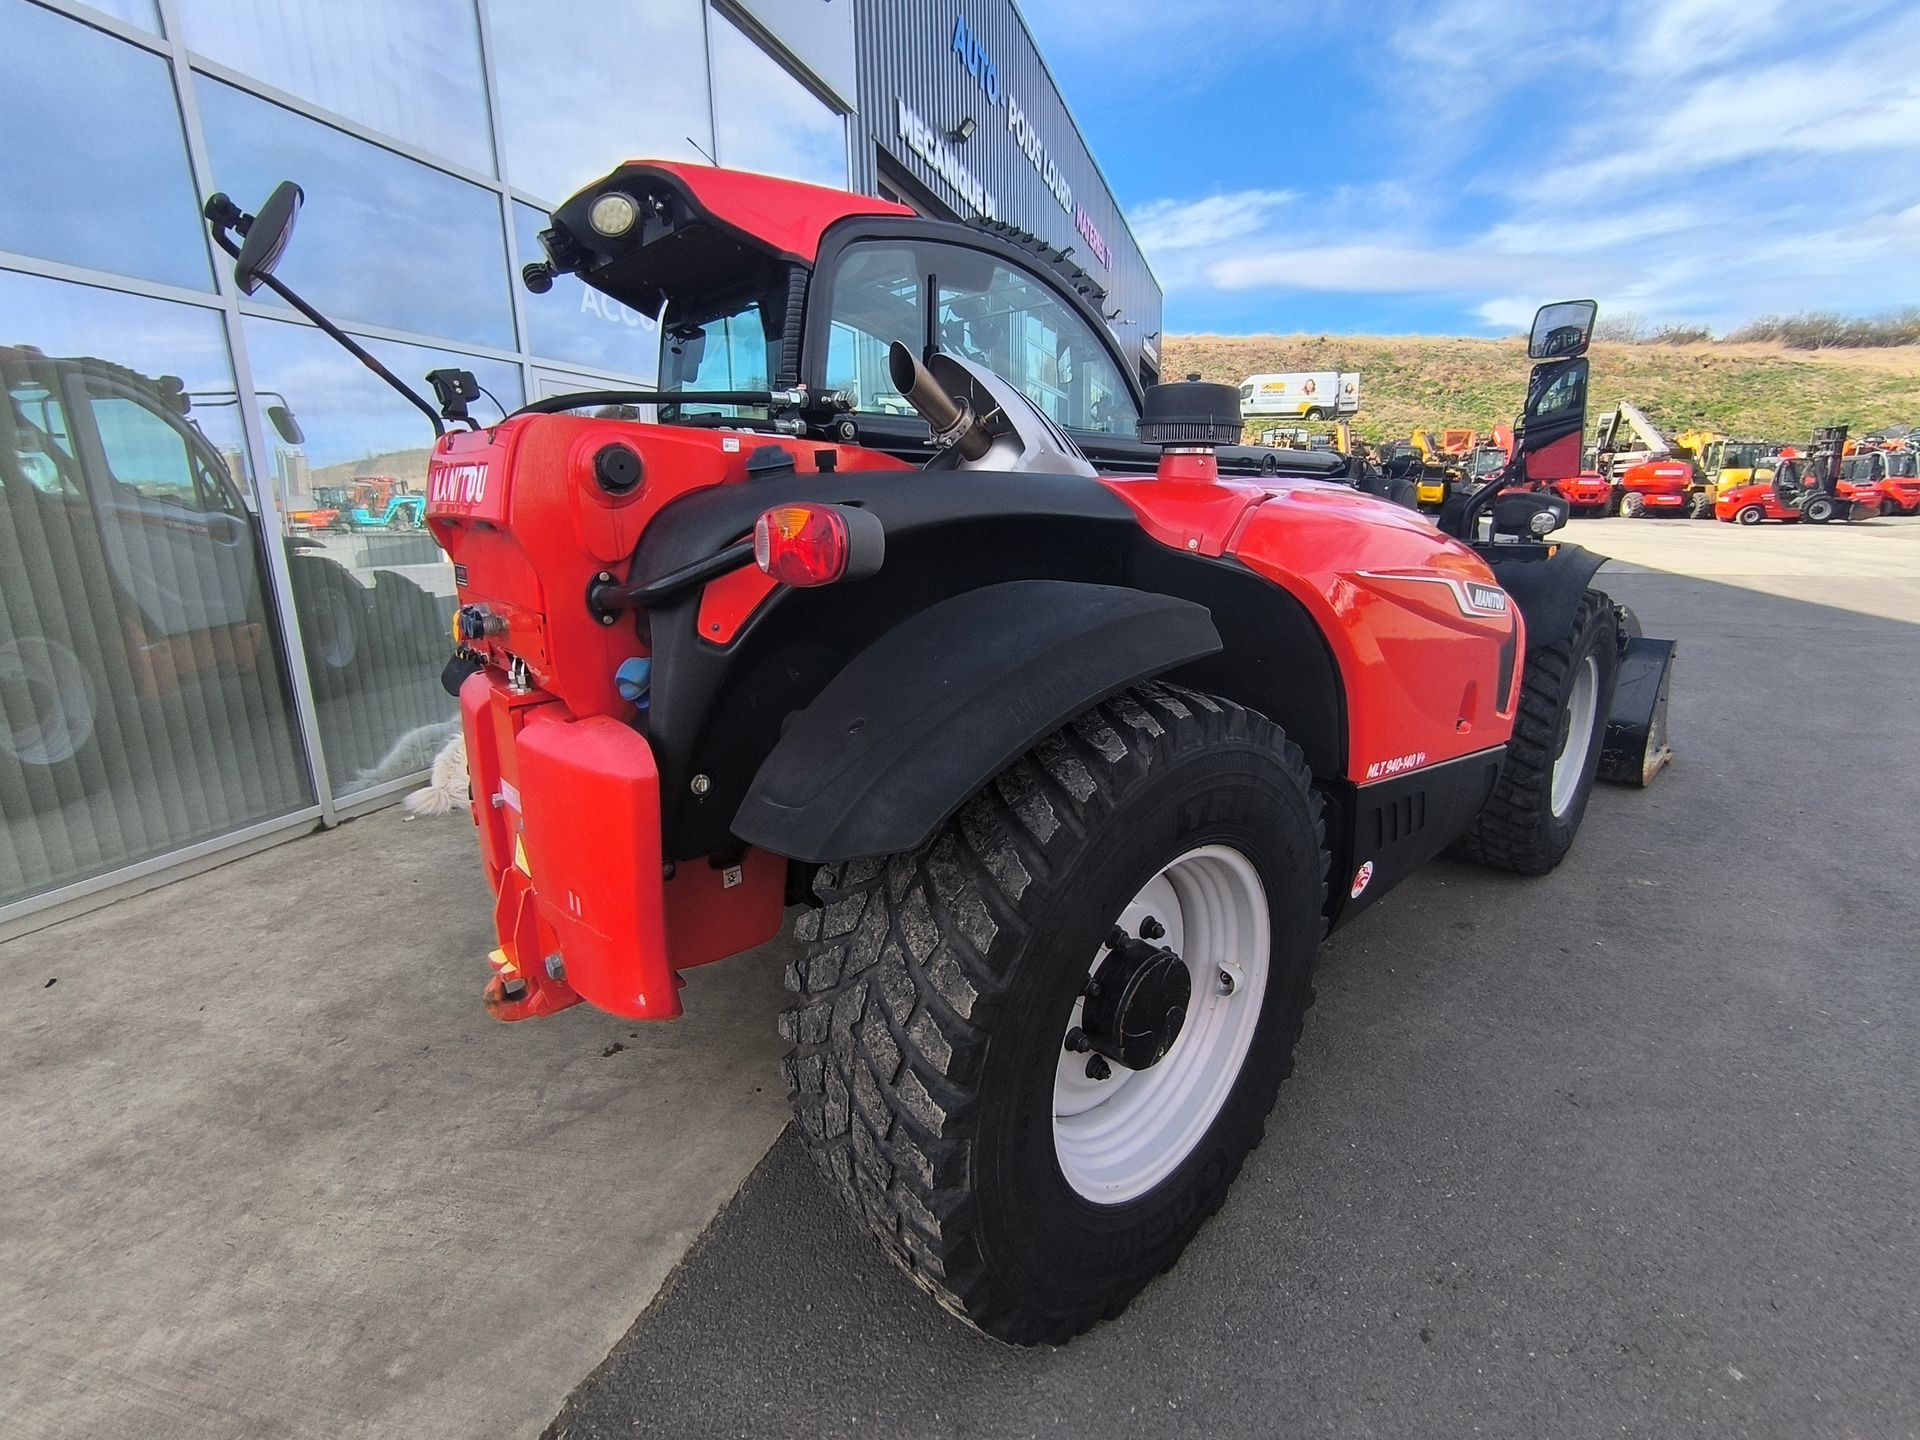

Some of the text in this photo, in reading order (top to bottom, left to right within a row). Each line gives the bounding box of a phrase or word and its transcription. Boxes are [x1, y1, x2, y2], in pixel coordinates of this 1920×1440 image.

[952, 14, 999, 106] AUTO
[1008, 94, 1042, 173] POIDS
[1043, 148, 1073, 215] LOURD
[897, 96, 984, 219] MECANIQUE
[1474, 588, 1505, 610] MANITOU
[1366, 761, 1387, 779] MLT
